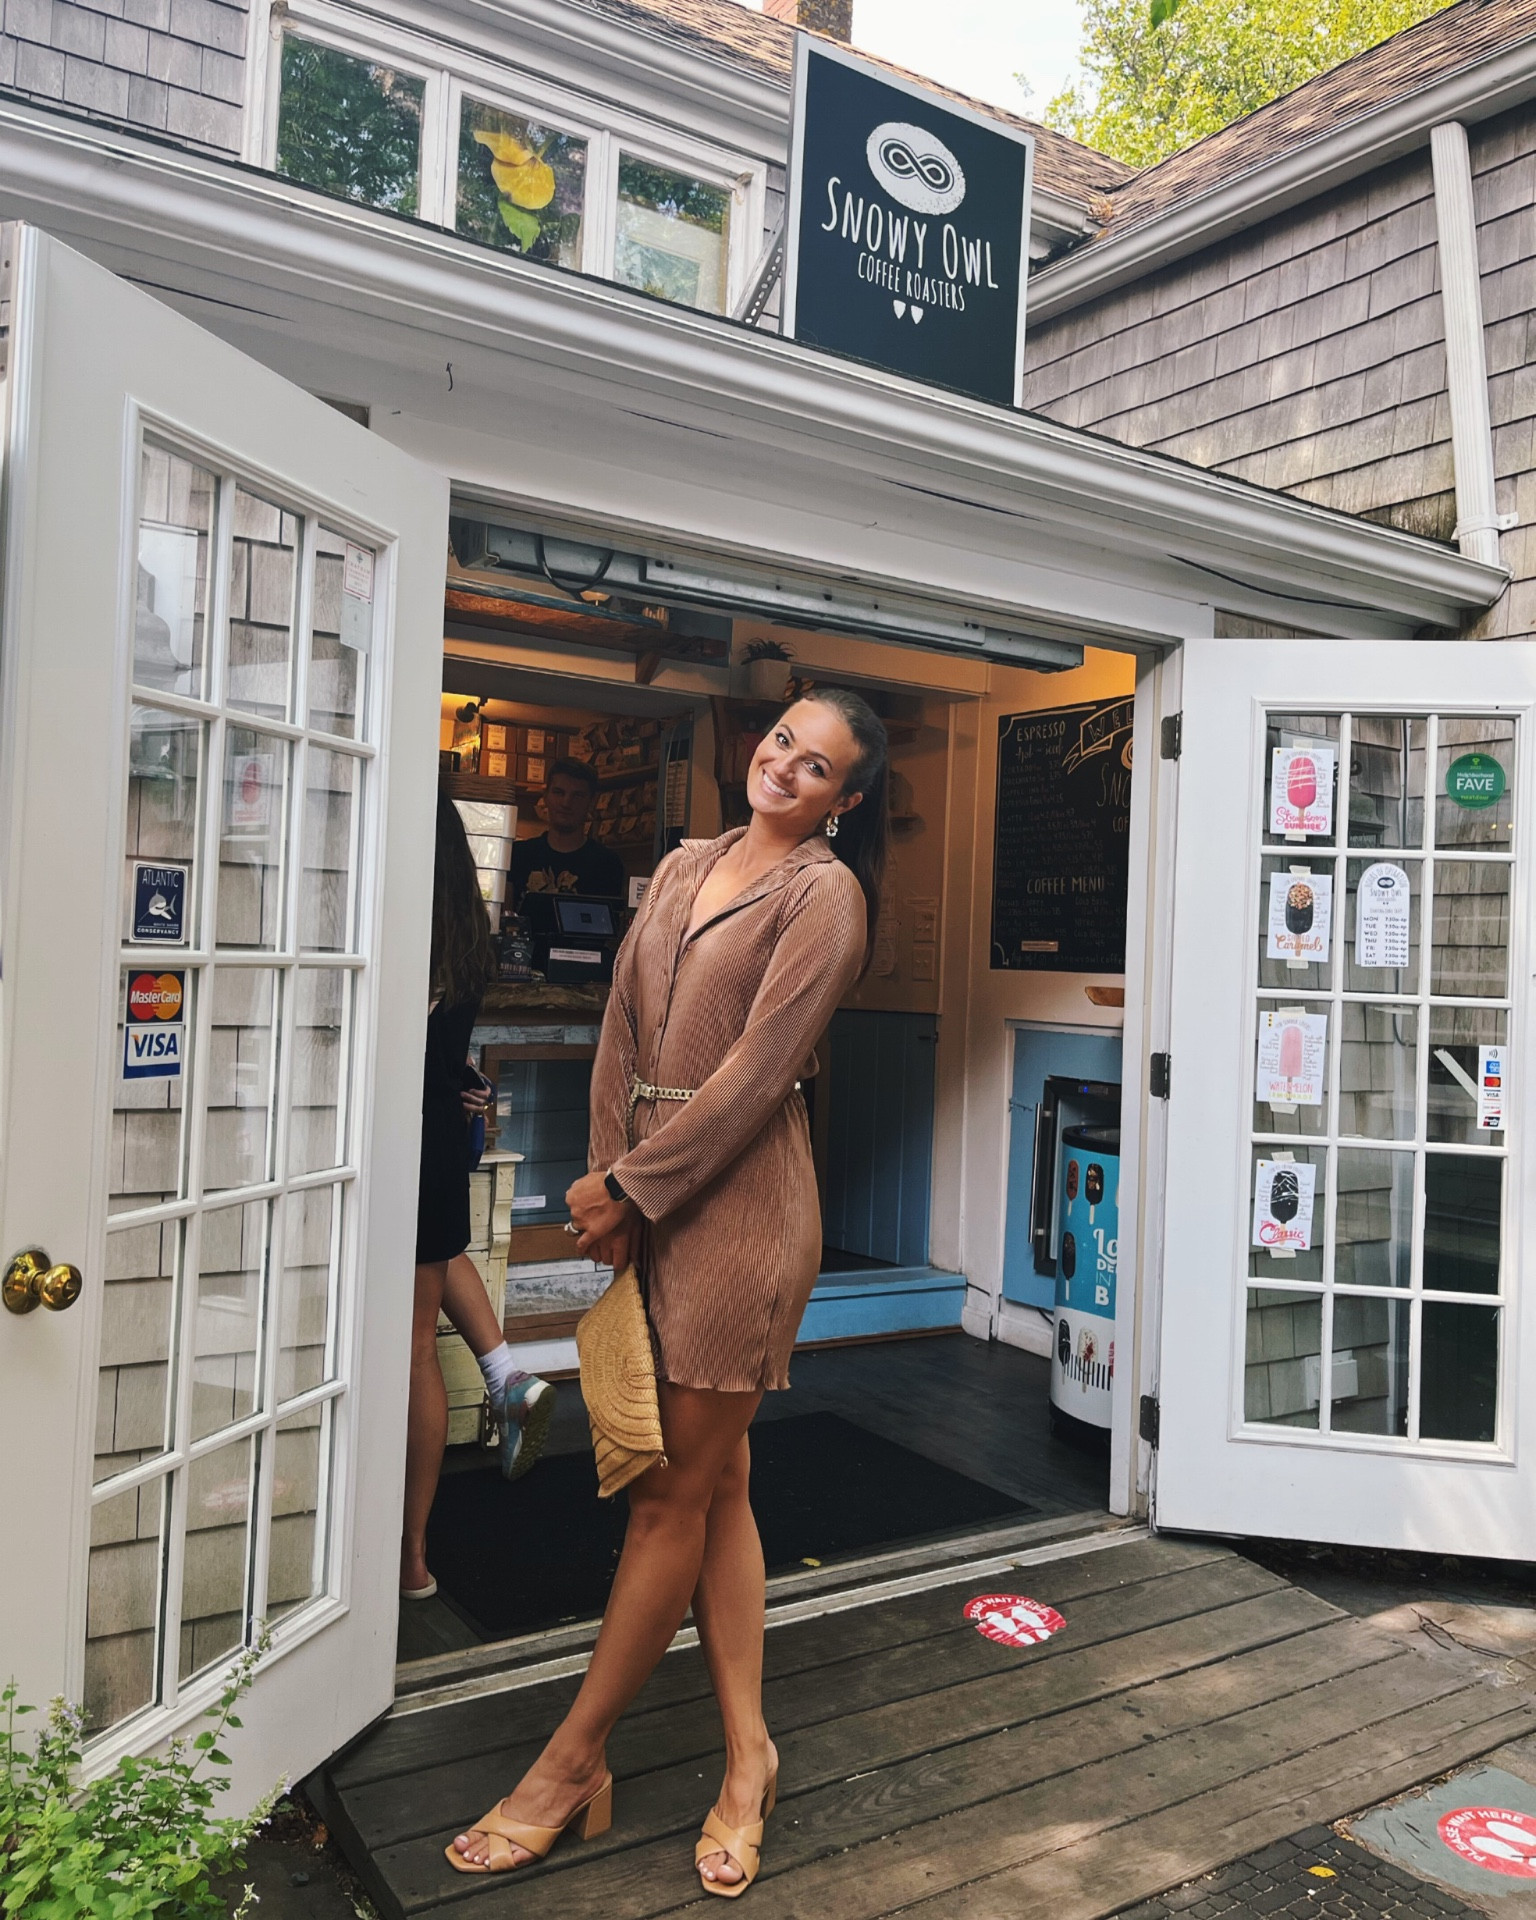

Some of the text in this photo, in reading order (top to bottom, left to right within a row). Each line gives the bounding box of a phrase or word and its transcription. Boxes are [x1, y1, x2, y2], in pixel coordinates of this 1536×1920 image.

[821, 176, 999, 289] SNOWY OWL
[857, 252, 966, 312] COFFEE ROASTERS
[1016, 720, 1066, 742] ESPRESSO
[1456, 778, 1494, 791] FAVE
[141, 868, 180, 888] ATLANTIC
[1026, 876, 1105, 895] COFFEE MENU
[130, 989, 181, 1004] MasterCard
[131, 1032, 178, 1058] VISA
[983, 1597, 1013, 1605] WAIT
[1445, 1810, 1524, 1862] PLEASE WAIT HERE
